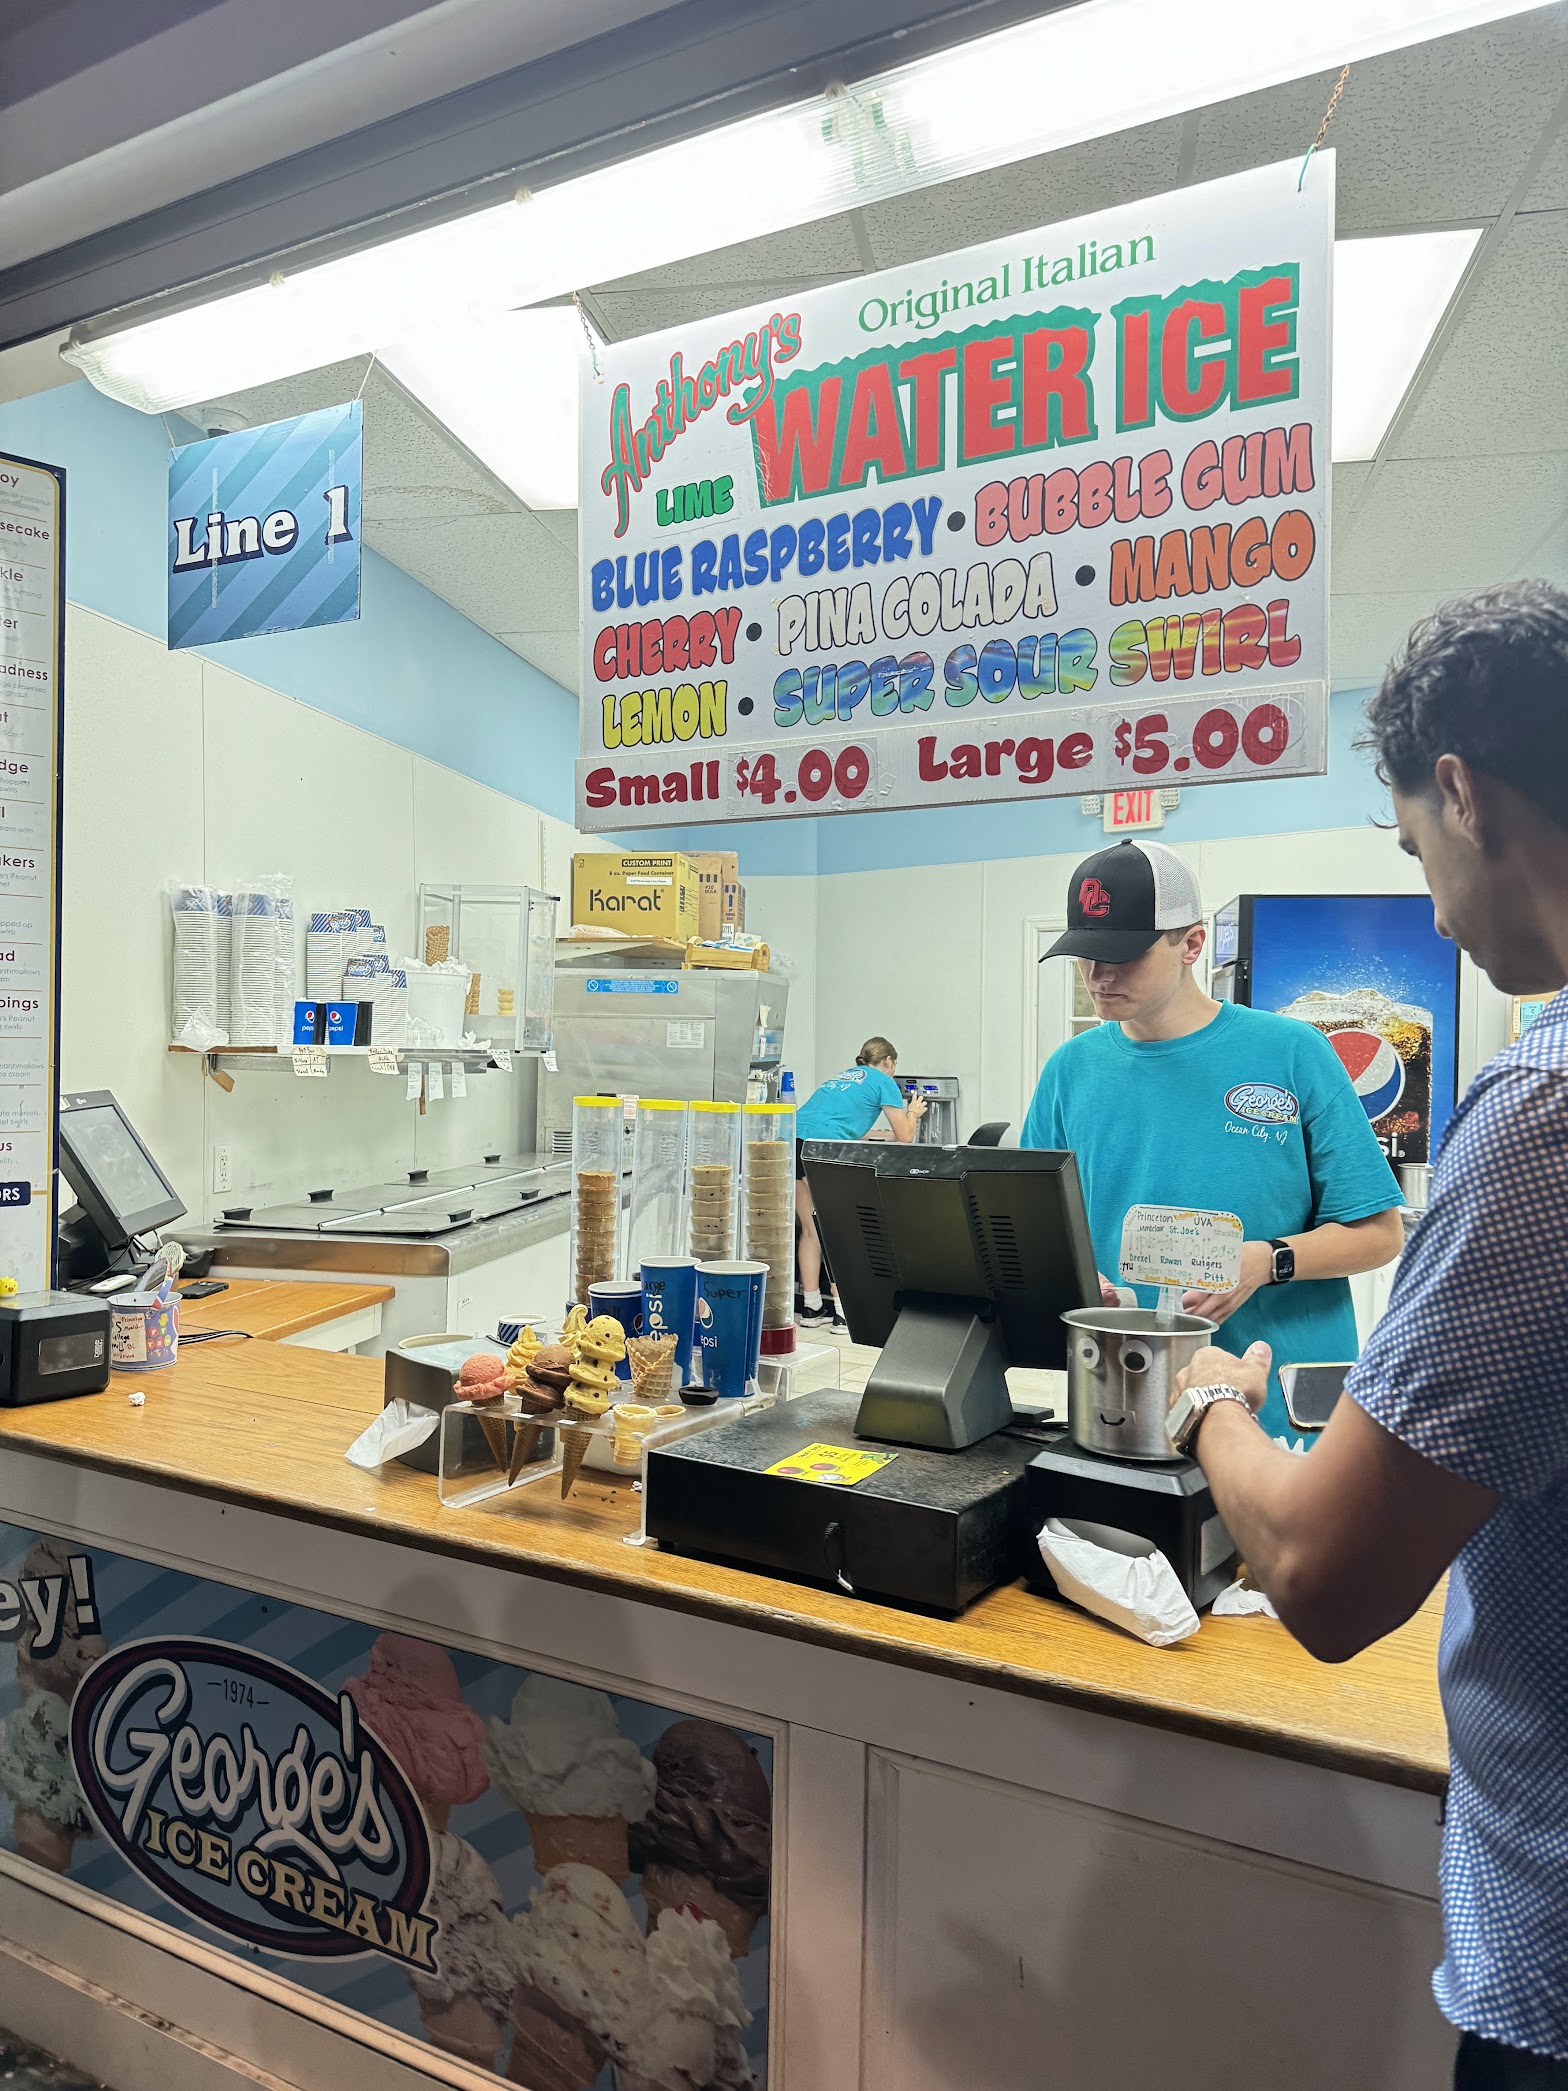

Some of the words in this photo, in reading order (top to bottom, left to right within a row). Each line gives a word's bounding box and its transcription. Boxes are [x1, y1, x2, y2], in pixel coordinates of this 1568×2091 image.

[858, 265, 1011, 333] Original
[1020, 234, 1156, 292] Italian
[600, 311, 803, 539] Anthony's
[745, 304, 1101, 509] WATER
[1112, 262, 1301, 435] ICE
[172, 508, 299, 574] Line
[322, 484, 354, 546] 1
[590, 545, 686, 612] BLUE
[690, 495, 944, 595] RASPBERRY
[974, 448, 1172, 546] BUBBLE
[1180, 423, 1316, 512] GUM
[656, 475, 734, 527] LIME
[592, 606, 743, 682] CHERRY
[772, 587, 874, 656] PINA
[881, 552, 1059, 639] COLADA
[1109, 509, 1317, 606] MANGO
[601, 679, 729, 750] LEMON
[772, 650, 937, 728] SUPER
[943, 626, 1100, 710] SOUR
[1108, 598, 1303, 687] SWIRL
[584, 759, 721, 809] Small
[735, 744, 871, 804] $4.00
[916, 730, 1095, 784] Large
[1113, 703, 1291, 774] $5.00
[1112, 789, 1155, 826] EXIT
[622, 859, 651, 867] CUSTOM
[651, 859, 673, 867] PRINT
[1230, 1086, 1294, 1114] George's
[1241, 1106, 1261, 1116] ICE
[1260, 1109, 1299, 1125] CREAM
[1129, 1252, 1151, 1264] Drexel
[1191, 1257, 1223, 1270] Rutgers
[1136, 1210, 1174, 1224] Princeton
[1193, 1216, 1213, 1228] UVA
[703, 1281, 746, 1300] Super
[1203, 1271, 1224, 1282] Pitt
[94, 1657, 398, 1877] George's
[142, 1808, 233, 1887] ICE
[236, 1847, 439, 1974] CREAM
